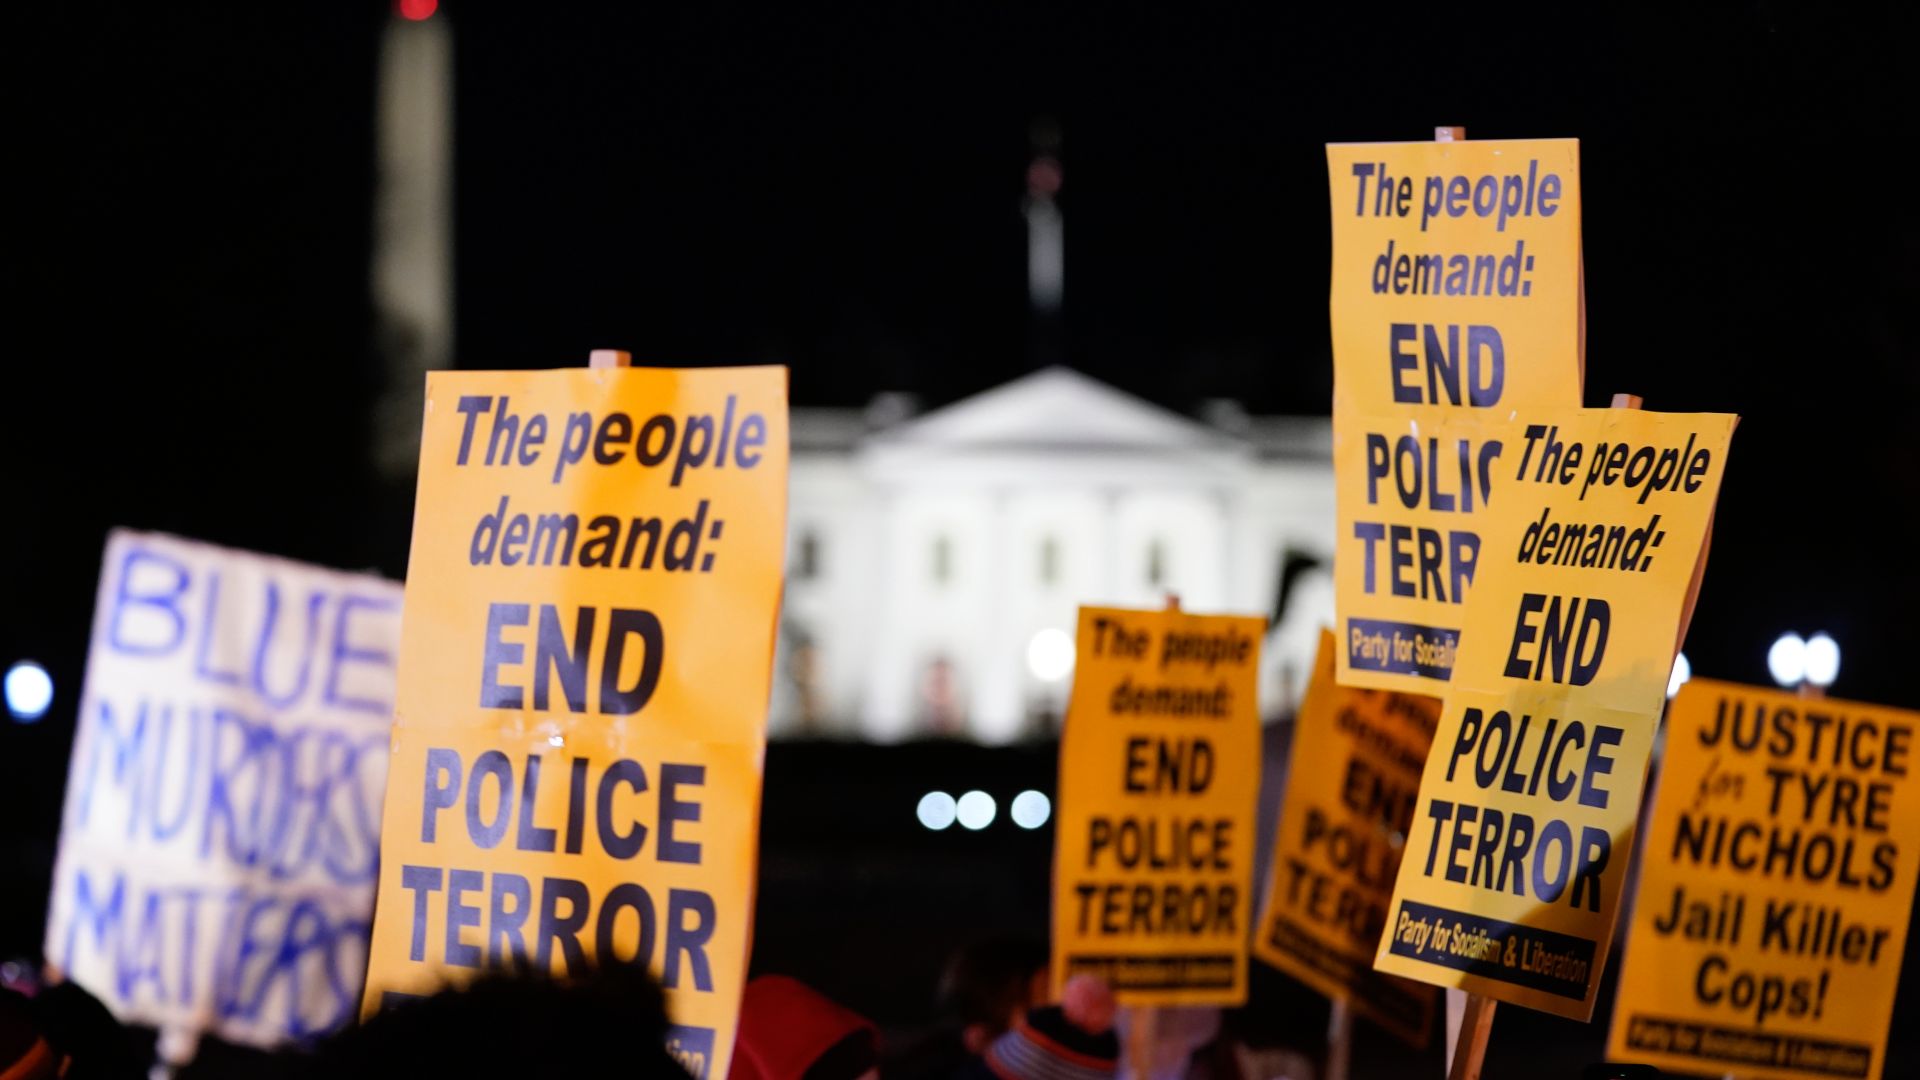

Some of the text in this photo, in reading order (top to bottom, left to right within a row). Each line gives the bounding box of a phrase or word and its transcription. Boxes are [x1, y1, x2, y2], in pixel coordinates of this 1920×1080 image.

[1352, 159, 1562, 232] The people
[1372, 240, 1535, 297] demand:
[1390, 323, 1505, 408] END
[456, 395, 766, 487] The people
[1366, 432, 1503, 513] POLIC
[1516, 425, 1710, 504] The people
[469, 496, 724, 572] demand:
[1354, 521, 1481, 605] TERR
[1517, 507, 1666, 572] demand:
[108, 545, 400, 716] BLUE
[480, 602, 664, 716] END
[1092, 618, 1151, 660] The
[1351, 627, 1391, 667] Party
[1393, 631, 1413, 663] for
[1503, 593, 1611, 686] END
[1124, 736, 1216, 796] END
[1446, 707, 1624, 809] POLICE
[1698, 697, 1912, 777] JUSTICE
[421, 748, 706, 865] POLICE
[1765, 767, 1894, 833] TYRE
[1086, 816, 1234, 872] POLICE
[1424, 798, 1611, 913] TERROR
[1672, 813, 1898, 893] NICHOLS
[402, 864, 717, 992] TERROR
[1075, 882, 1239, 936] TERROR
[1396, 911, 1588, 984] Party for Socialism & Liberation
[1654, 886, 1890, 966] Jail Killer
[1695, 953, 1830, 1026] Cops!
